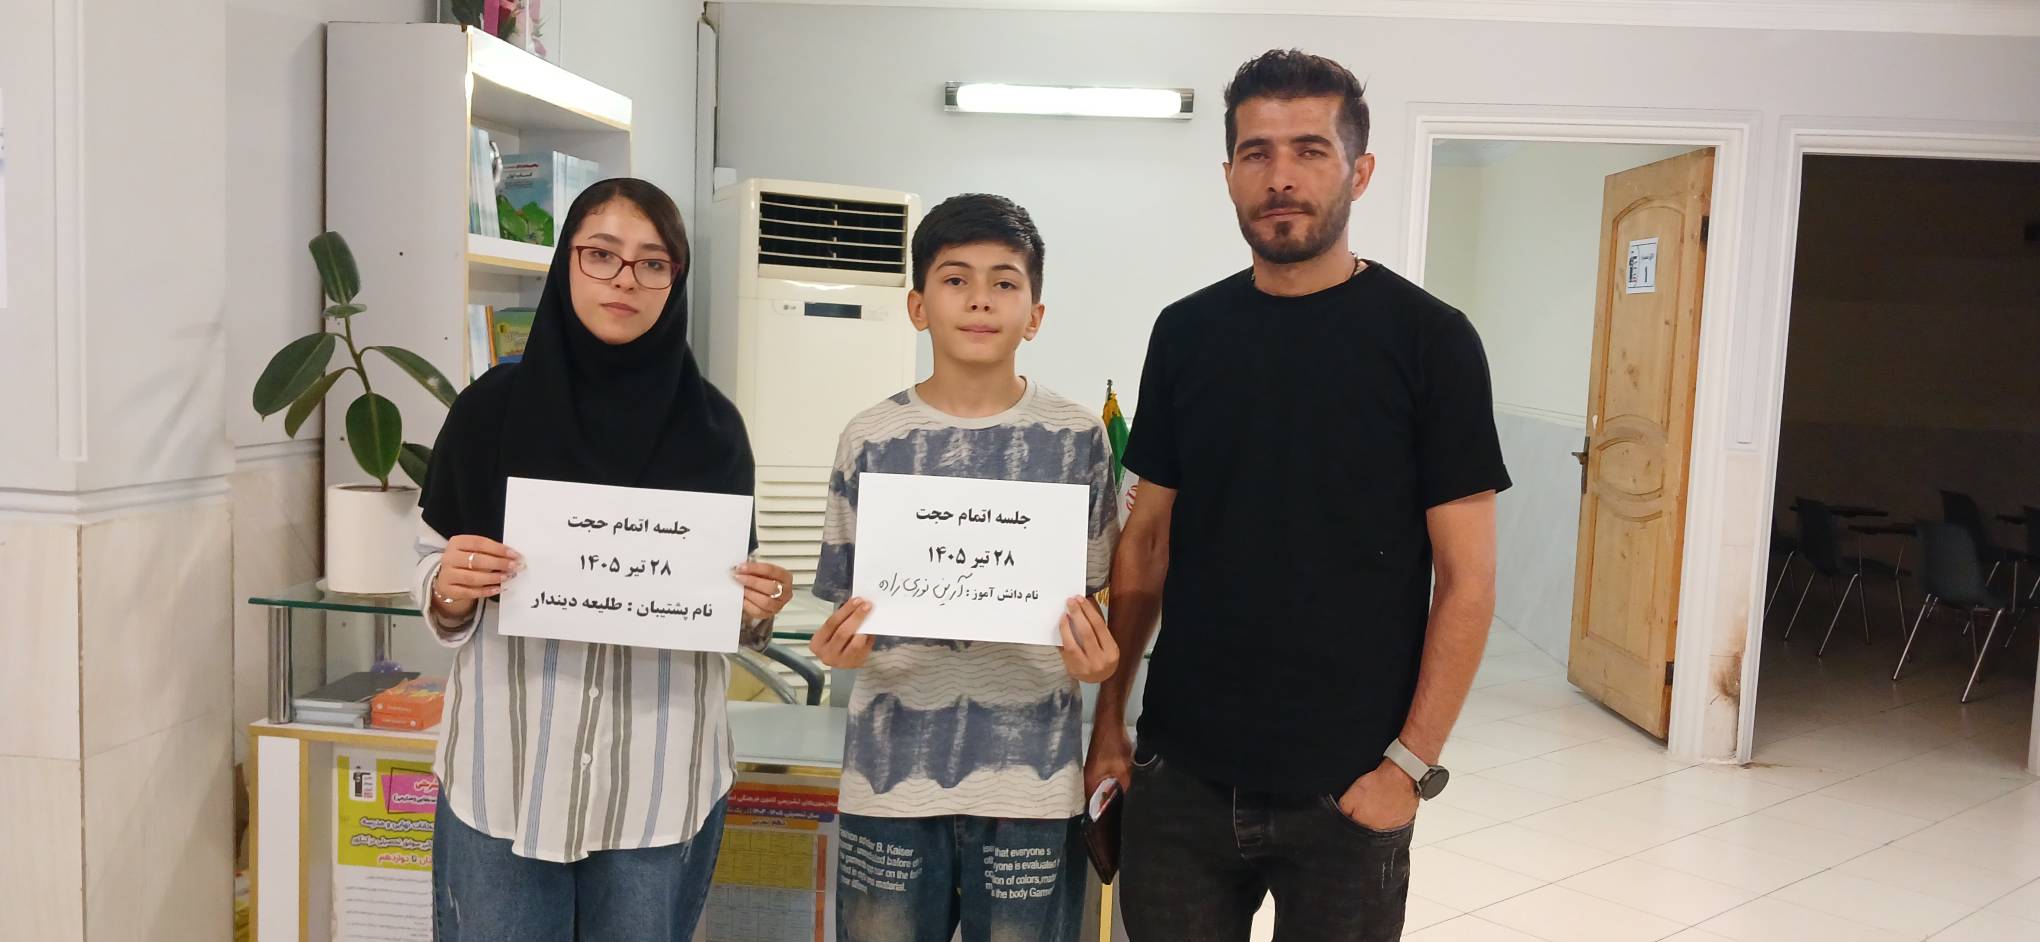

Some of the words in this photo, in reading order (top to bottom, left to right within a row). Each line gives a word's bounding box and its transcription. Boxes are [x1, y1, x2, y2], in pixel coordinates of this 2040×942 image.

[568, 514, 608, 533] حجت
[916, 506, 954, 524] حجت
[958, 508, 991, 526] اتمام
[995, 510, 1031, 530] جلسه
[613, 517, 648, 535] اتمام
[654, 520, 691, 540] جلسه
[580, 554, 620, 573] ۱۴۰۵
[928, 546, 966, 565] ۱۴۰۵
[970, 550, 990, 568] تیر
[994, 549, 1015, 567] ۲۸
[625, 560, 646, 577] تیر
[651, 559, 672, 576] ۲۸
[531, 592, 578, 611] دیندار
[997, 586, 1023, 602] دانش
[1025, 588, 1039, 603] نام
[582, 596, 623, 614] طلیعه
[636, 600, 689, 621] پشتیبان
[692, 601, 713, 621] نام
[887, 844, 914, 857] Kaiser
[1010, 848, 1045, 858] everyone
[885, 869, 895, 878] on
[896, 870, 909, 880] the
[1006, 875, 1015, 885] of
[1009, 889, 1028, 899] body
